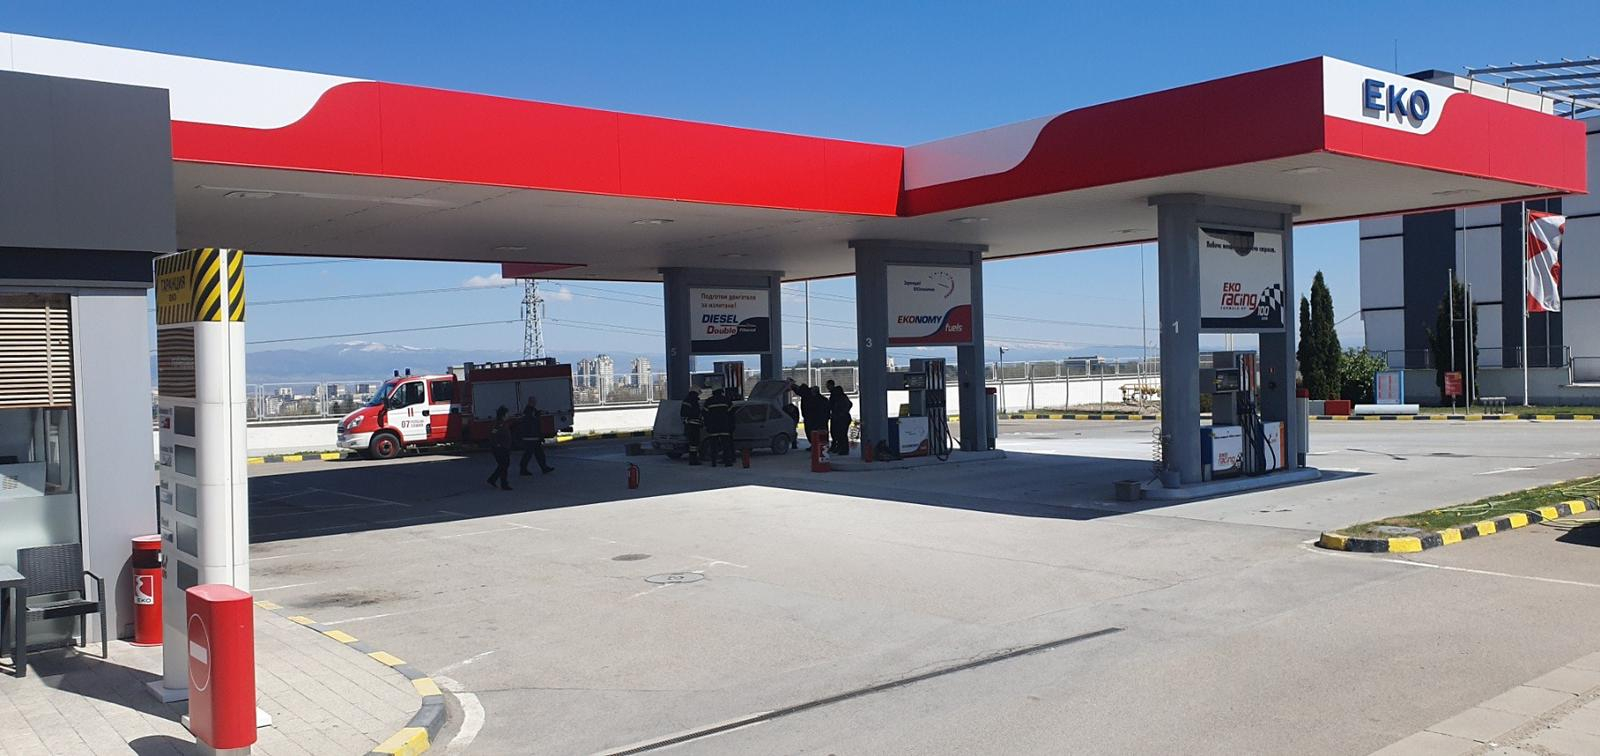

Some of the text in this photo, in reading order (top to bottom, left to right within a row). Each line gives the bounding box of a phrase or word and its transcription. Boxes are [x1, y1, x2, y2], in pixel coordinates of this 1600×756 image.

[1363, 78, 1430, 122] EKO
[1223, 282, 1241, 292] EKO
[1221, 293, 1257, 310] racing
[1257, 306, 1270, 316] 100
[702, 314, 739, 324] DIESEL
[897, 315, 942, 324] EKONOMY
[707, 325, 737, 335] Double
[945, 323, 963, 332] fuels
[1172, 321, 1179, 334] 1
[866, 337, 873, 348] 3
[401, 420, 410, 428] 07
